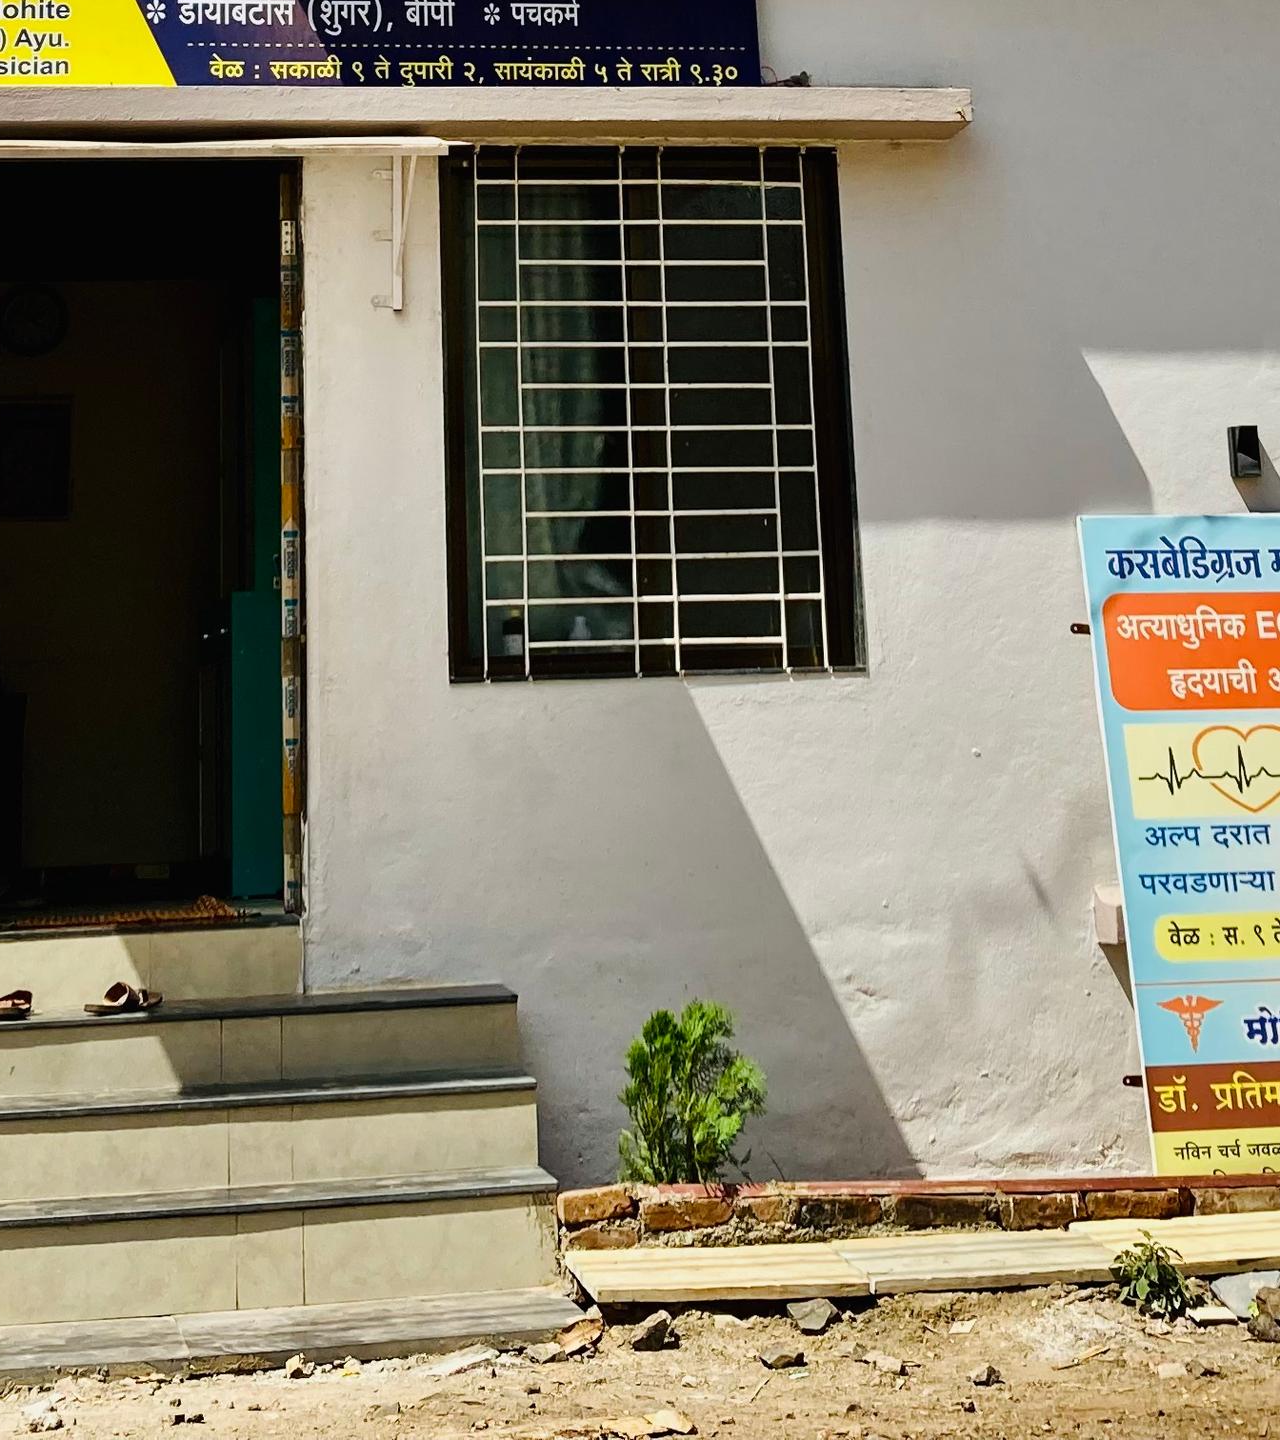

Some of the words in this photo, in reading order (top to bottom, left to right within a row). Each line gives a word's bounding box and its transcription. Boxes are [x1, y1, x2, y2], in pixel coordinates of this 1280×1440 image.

[15, 28, 71, 55] Ayu.
[210, 55, 245, 81] वेळ
[269, 55, 342, 82] सकाळी
[353, 62, 365, 81] ९
[375, 55, 392, 81] ते
[400, 55, 453, 87] दुपारी
[463, 62, 485, 83] २,
[494, 52, 587, 82] सायंकाळी
[595, 62, 608, 82] ५
[616, 55, 632, 81] ते
[641, 53, 680, 83] रात्री
[690, 62, 739, 85] ९.३०
[1117, 605, 1247, 650] अत्याधुनिक
[1145, 824, 1200, 848] अल्प
[1211, 823, 1271, 847] दरात
[1169, 921, 1201, 947] वेळ
[1222, 925, 1245, 945] स.
[1254, 923, 1266, 946] ९
[1153, 1075, 1199, 1113] डॉ.
[1173, 1141, 1211, 1161] नविन
[1217, 1139, 1241, 1158] चर्च
